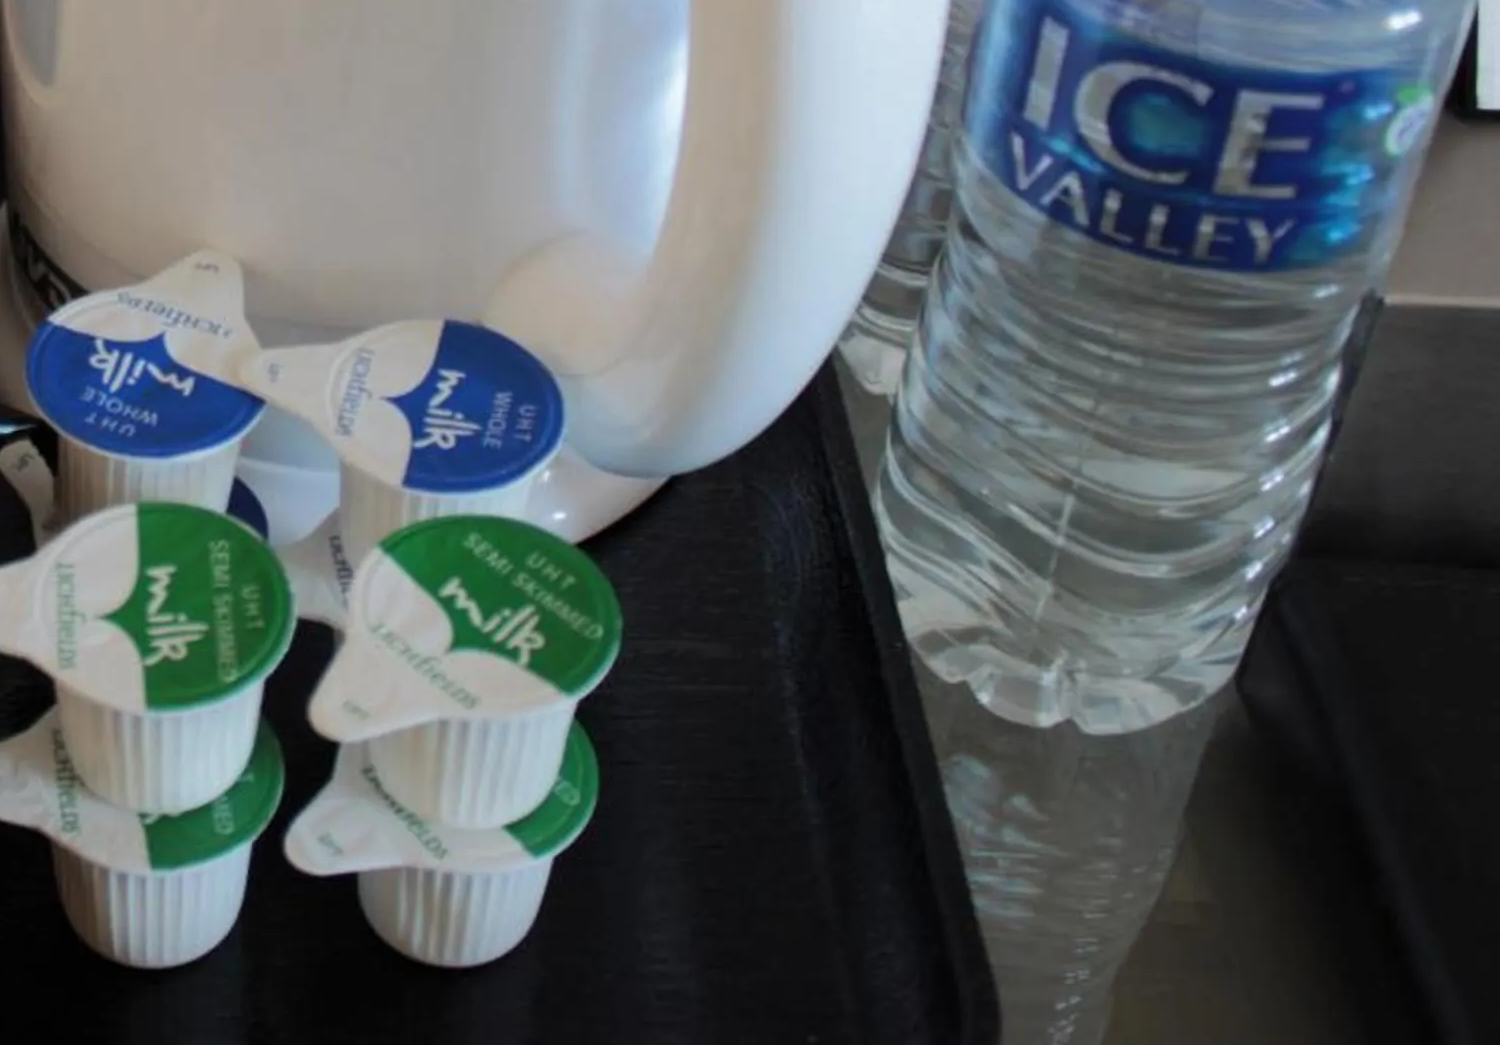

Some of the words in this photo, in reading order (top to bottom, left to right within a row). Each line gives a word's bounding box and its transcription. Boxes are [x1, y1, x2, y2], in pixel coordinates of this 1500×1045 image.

[1023, 16, 1326, 200] ICE
[1009, 131, 1295, 266] VALLEY
[89, 338, 196, 397] milk
[81, 386, 158, 427] WHOLE
[85, 412, 136, 437] UHT
[413, 368, 483, 450] milk
[483, 391, 513, 449] WHOLE
[513, 402, 537, 443] UHT
[209, 539, 232, 589] SEMI
[463, 532, 513, 576] SEMI
[512, 573, 605, 641] SKIMMED
[525, 551, 576, 589] UHT
[143, 563, 209, 667] milk
[241, 584, 265, 629] UHT
[439, 576, 546, 667] milk
[212, 593, 241, 684] SKIMMED
